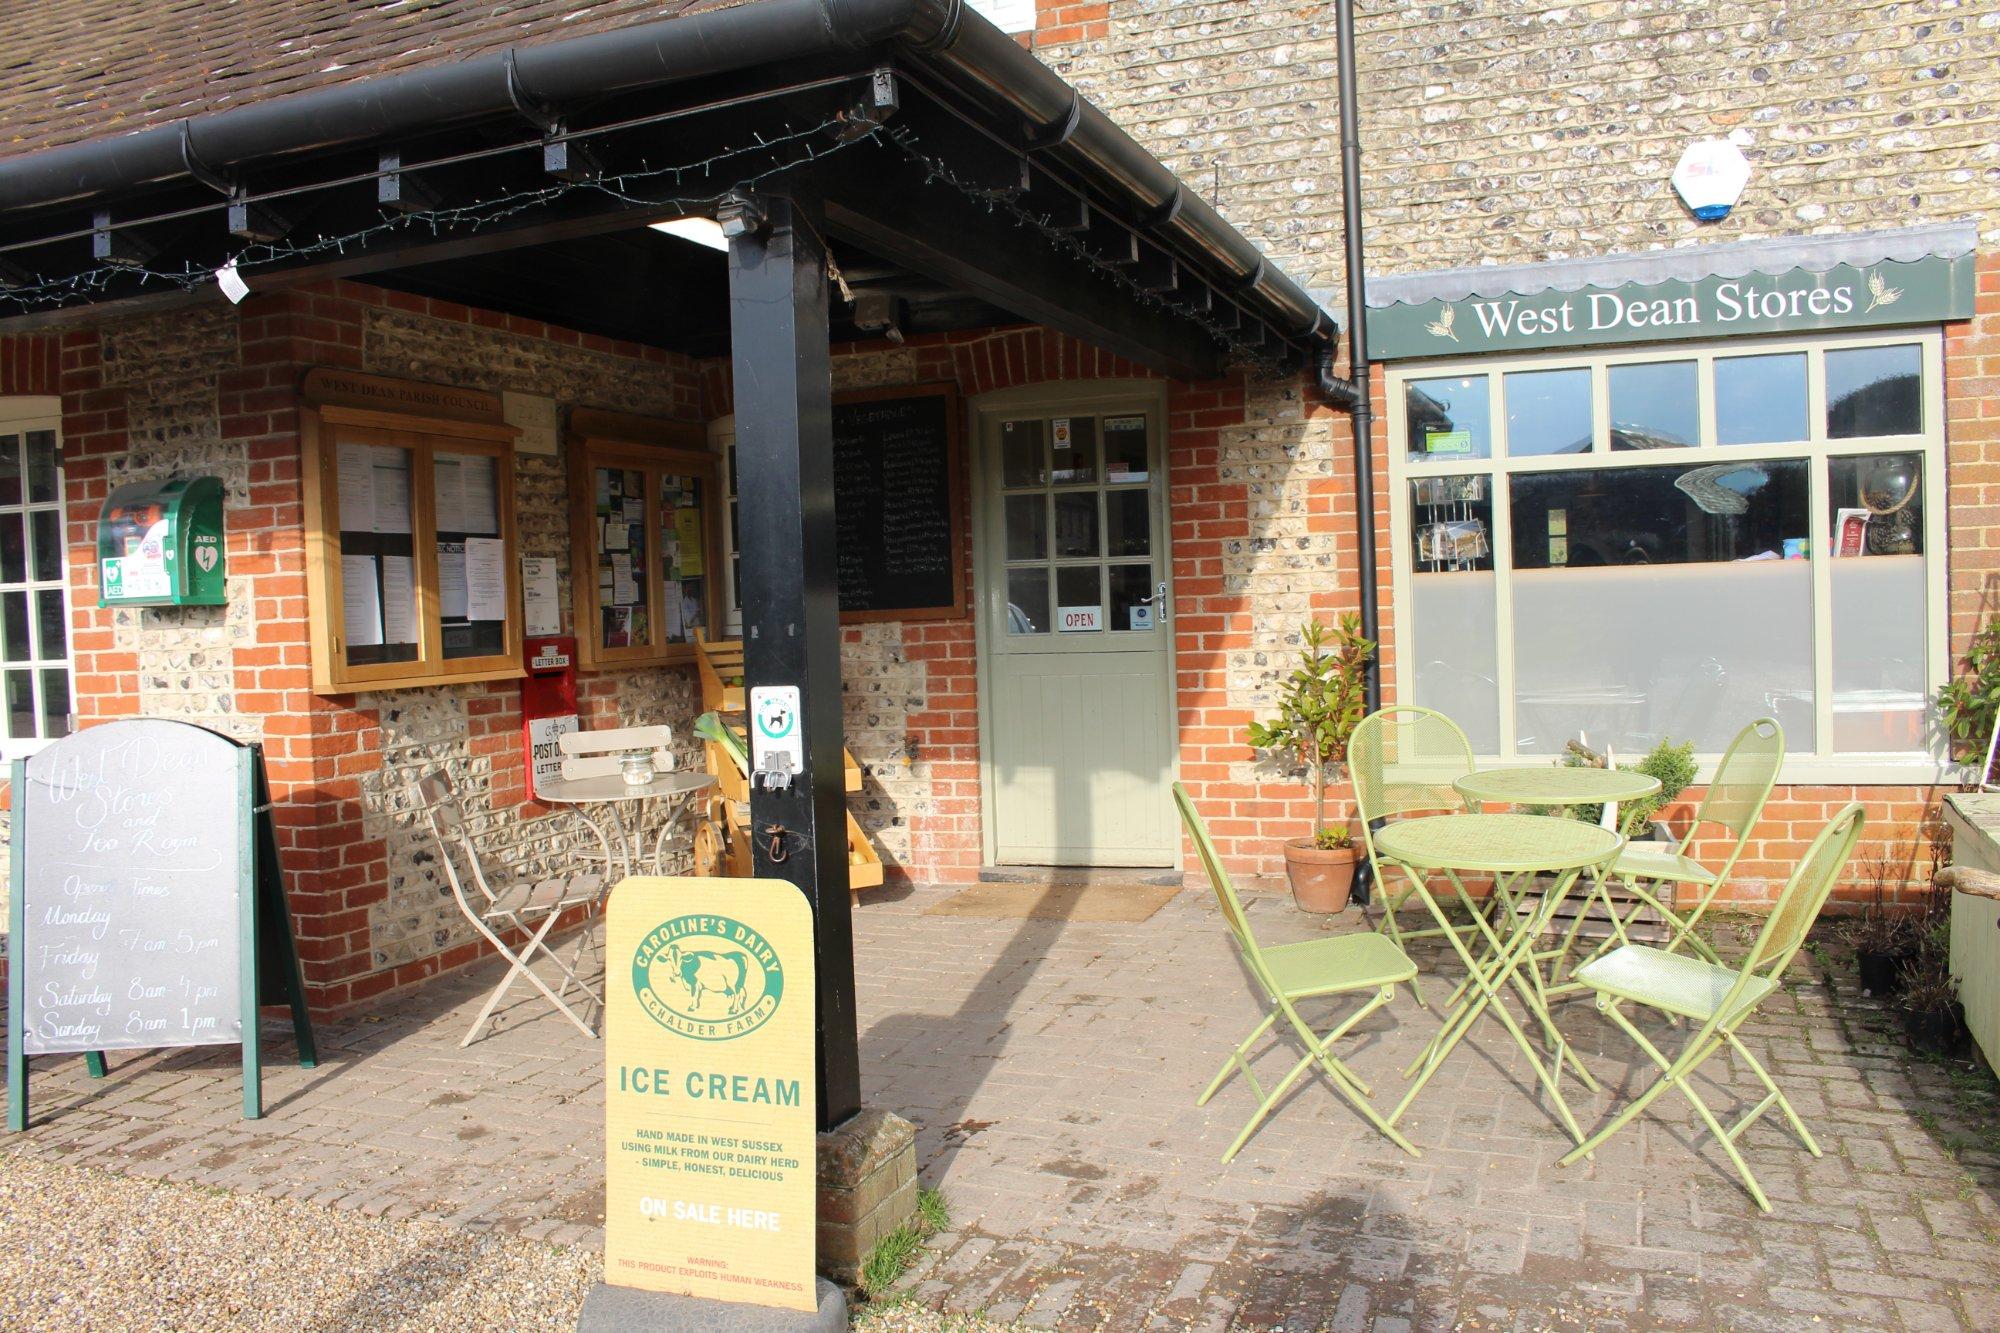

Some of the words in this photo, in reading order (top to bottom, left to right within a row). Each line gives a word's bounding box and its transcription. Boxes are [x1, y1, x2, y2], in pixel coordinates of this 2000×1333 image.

[1471, 299, 1575, 339] West
[1586, 292, 1701, 331] Dean
[1715, 282, 1854, 323] Stores
[319, 377, 358, 392] WEST
[361, 383, 396, 398] DEAN
[399, 390, 440, 404] PARISH
[443, 395, 492, 412] COUNCIL
[194, 535, 217, 543] AED
[108, 585, 123, 595] AED
[1065, 612, 1095, 627] OPEN
[535, 656, 555, 666] LETTER
[555, 656, 567, 665] BOX
[119, 736, 209, 778] Dean
[533, 742, 553, 760] POST
[537, 761, 562, 774] LETTER
[75, 785, 173, 830] Stores
[123, 806, 161, 829] and
[79, 828, 119, 853] Tea
[130, 829, 199, 857] Room
[128, 877, 170, 897] Times
[39, 904, 112, 941] Monday
[39, 941, 99, 980] Friday
[636, 917, 726, 968] CAROLINE'S
[734, 925, 780, 973] DAIRY
[38, 980, 113, 1017] Saturday
[38, 1011, 101, 1045] Sunday
[648, 1000, 717, 1036] CHALDER
[727, 1007, 766, 1035] FARM
[620, 1065, 671, 1096] ICE
[685, 1071, 801, 1107] CREAM
[621, 1141, 652, 1154] USING
[653, 1144, 678, 1157] MILK
[680, 1147, 710, 1160] FROM
[712, 1150, 735, 1163] OUR
[737, 1153, 768, 1166] DAIRY
[770, 1157, 800, 1170] HERD
[636, 1128, 664, 1141] HAND
[666, 1131, 695, 1144] MADE
[697, 1134, 709, 1146] IN
[711, 1136, 739, 1149] WEST
[741, 1139, 784, 1153] SUSSEX
[641, 1157, 682, 1173] SIMPLE,
[684, 1161, 727, 1177] HONEST,
[729, 1166, 785, 1182] DELICIOUS
[639, 1196, 668, 1218] ON
[673, 1200, 722, 1225] SALE
[727, 1207, 782, 1233] HERE
[617, 1258, 636, 1269] THIS
[638, 1260, 677, 1276] PRODUCT
[678, 1266, 718, 1281] EXPLOITS
[720, 1272, 752, 1286] HUMAN
[754, 1277, 804, 1293] WEAKNESS
[686, 1255, 729, 1270] WARNING:
